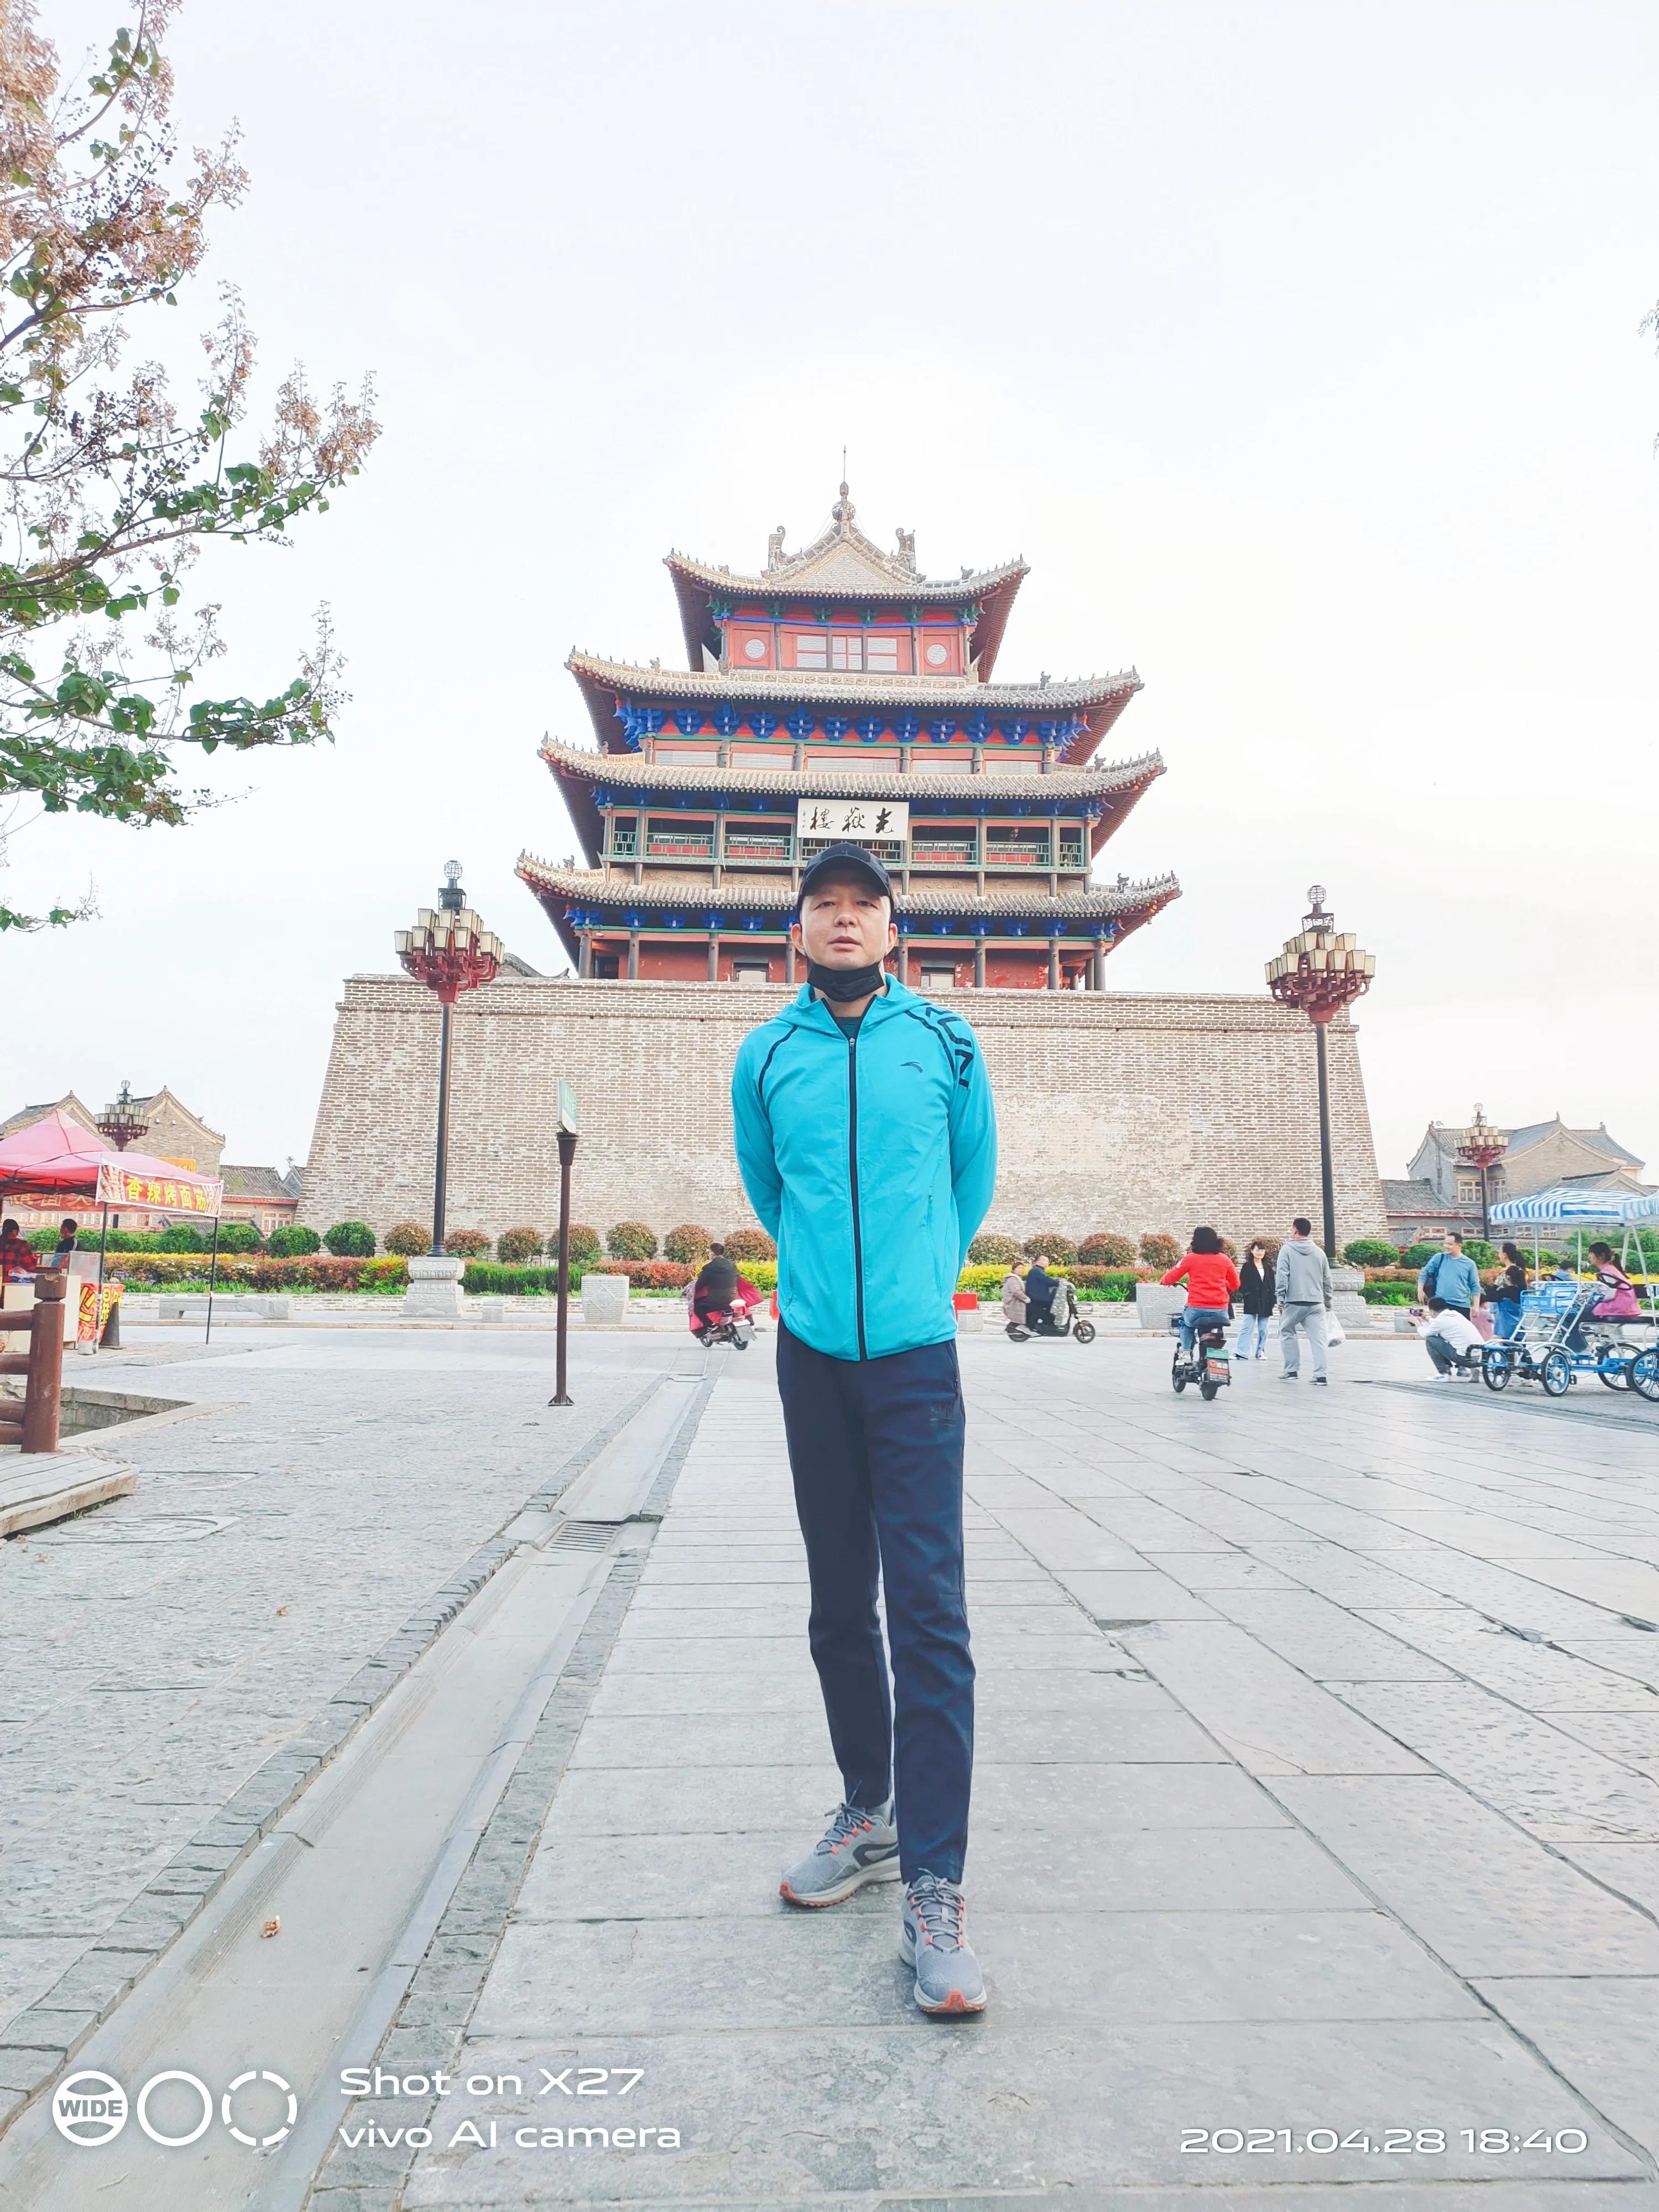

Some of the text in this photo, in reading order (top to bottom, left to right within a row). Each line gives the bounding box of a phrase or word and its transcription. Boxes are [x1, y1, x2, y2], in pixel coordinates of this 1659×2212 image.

[126, 1176, 207, 1212] 香辣烤面筋
